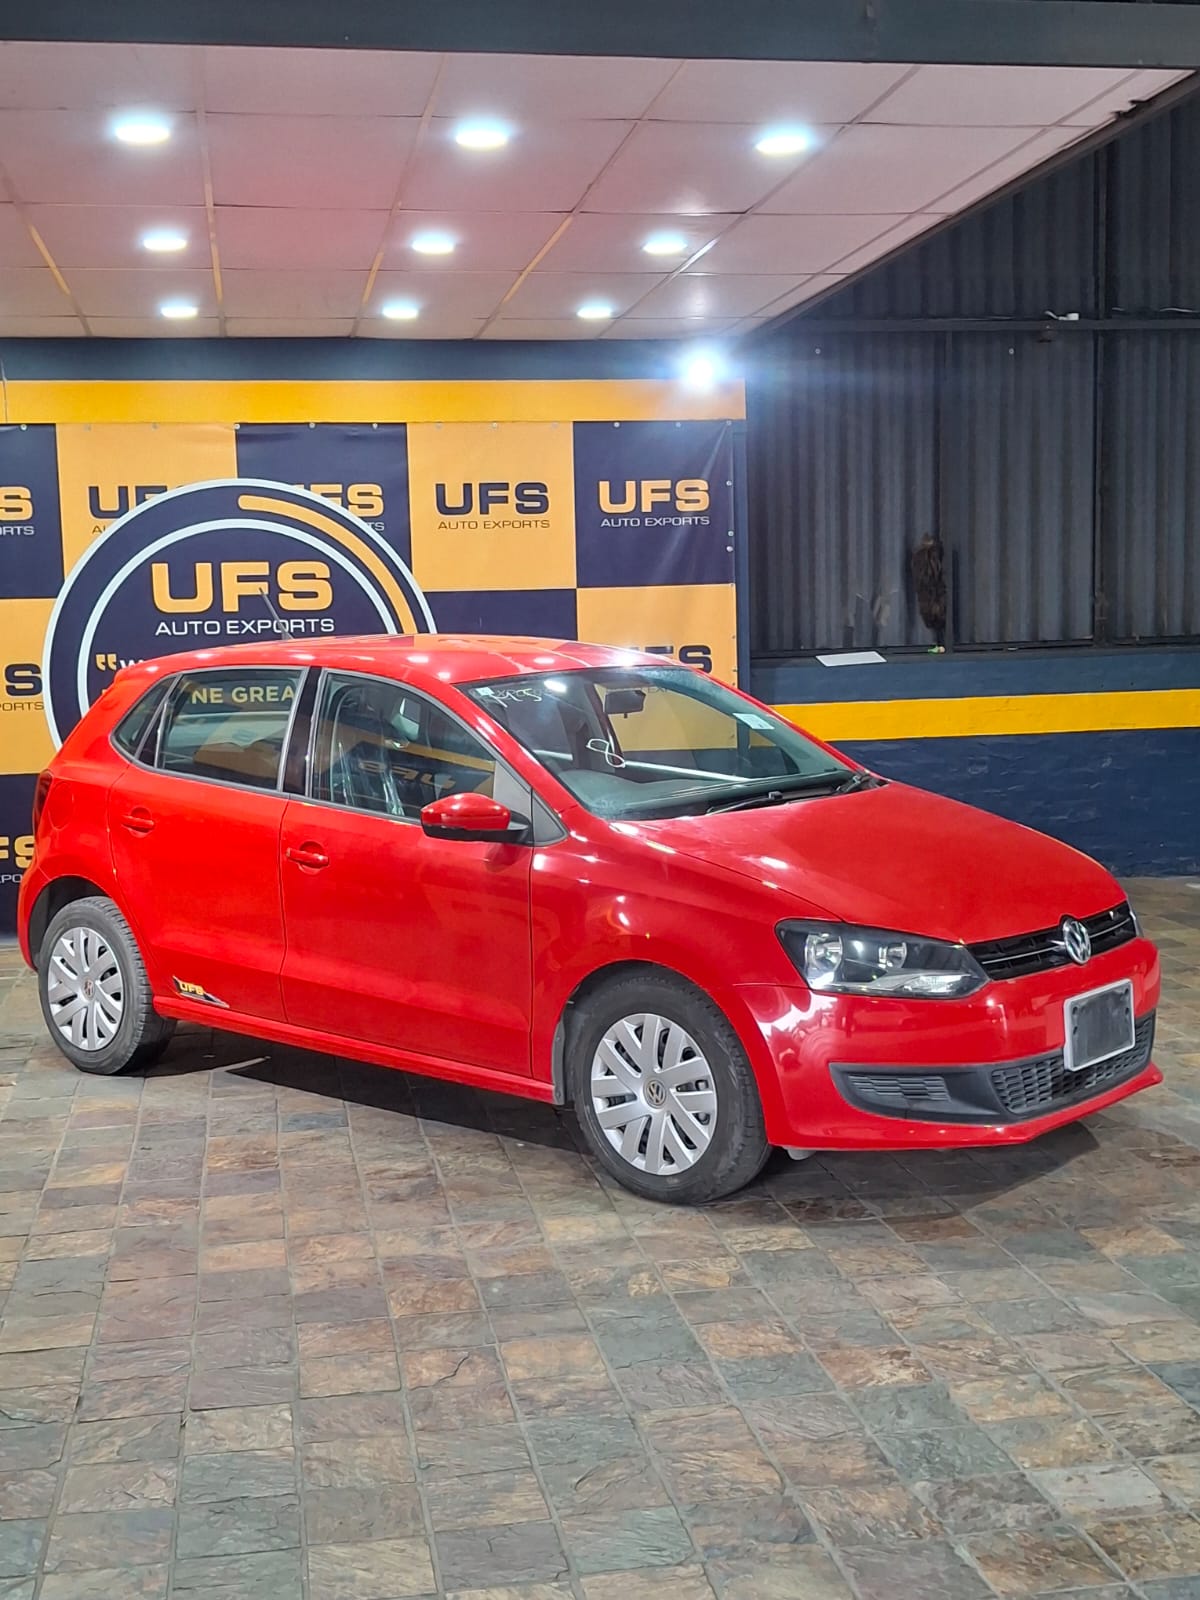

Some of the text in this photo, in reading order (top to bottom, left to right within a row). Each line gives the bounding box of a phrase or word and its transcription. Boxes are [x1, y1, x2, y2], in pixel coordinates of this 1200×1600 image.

[435, 482, 549, 516] UFS
[599, 479, 710, 514] UFS
[438, 519, 550, 530] AUTO EXPORTS
[601, 516, 710, 528] AUTO EXPORTS
[151, 561, 332, 614] UFS
[155, 618, 335, 636] AUTO EXPORTS
